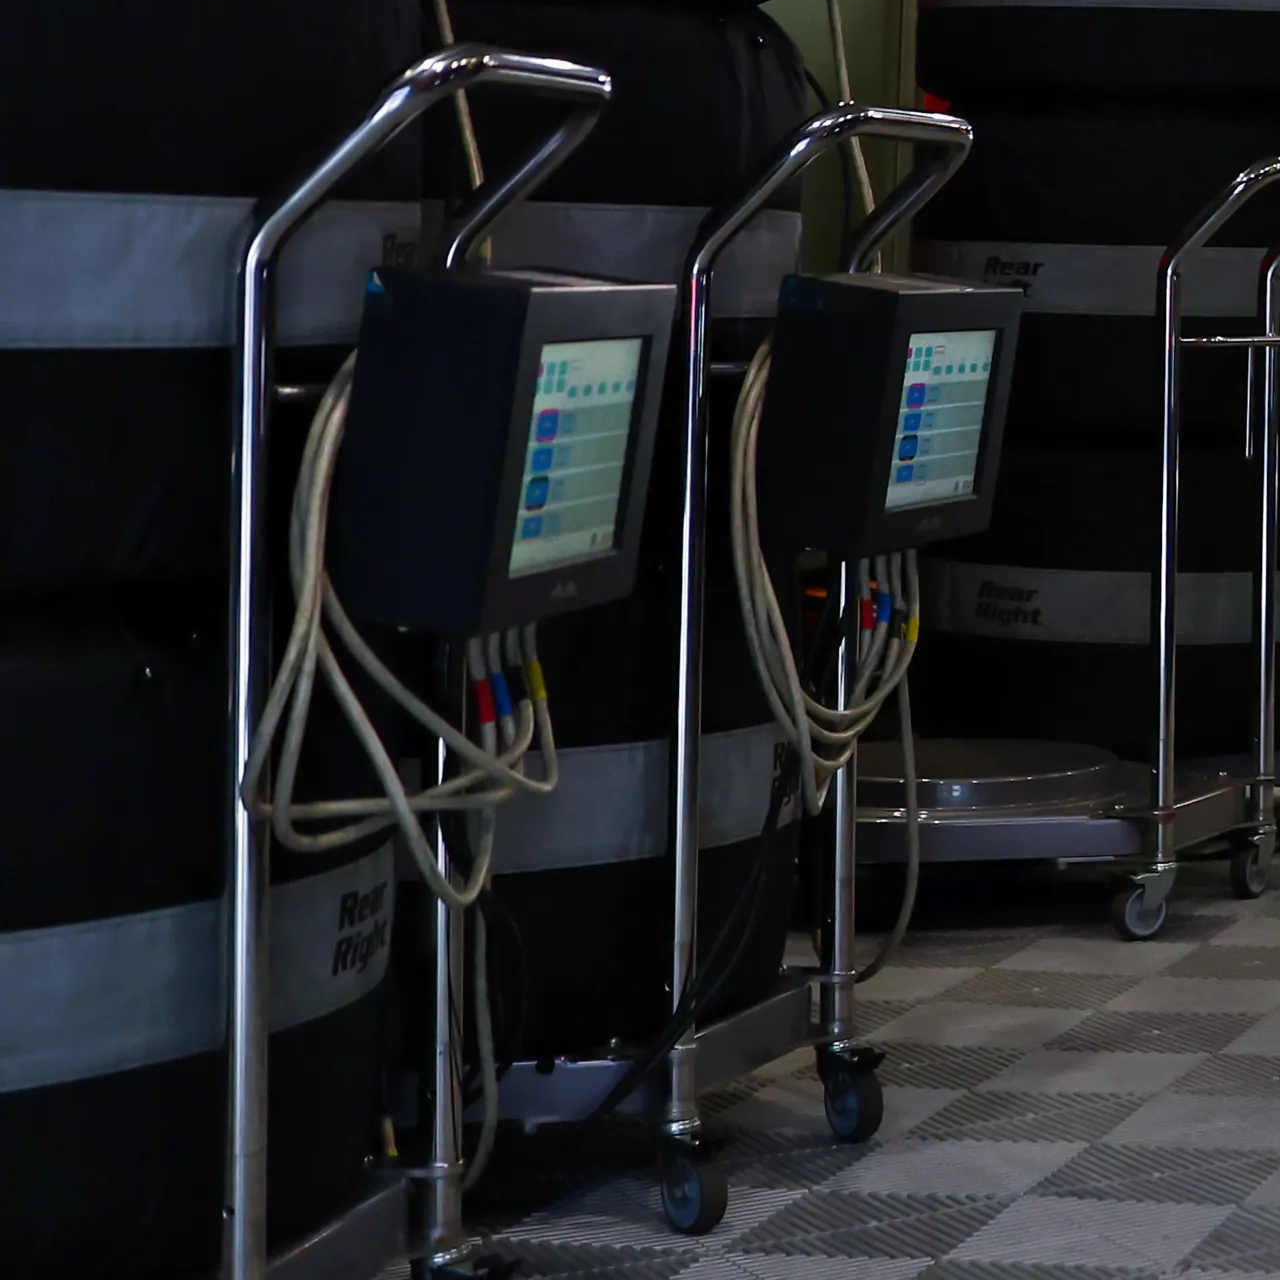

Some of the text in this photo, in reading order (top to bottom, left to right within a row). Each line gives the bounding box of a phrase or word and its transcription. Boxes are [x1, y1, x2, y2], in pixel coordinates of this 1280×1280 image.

[984, 255, 1045, 276] Rear
[979, 580, 1040, 603] Rear
[338, 880, 388, 934] Rear
